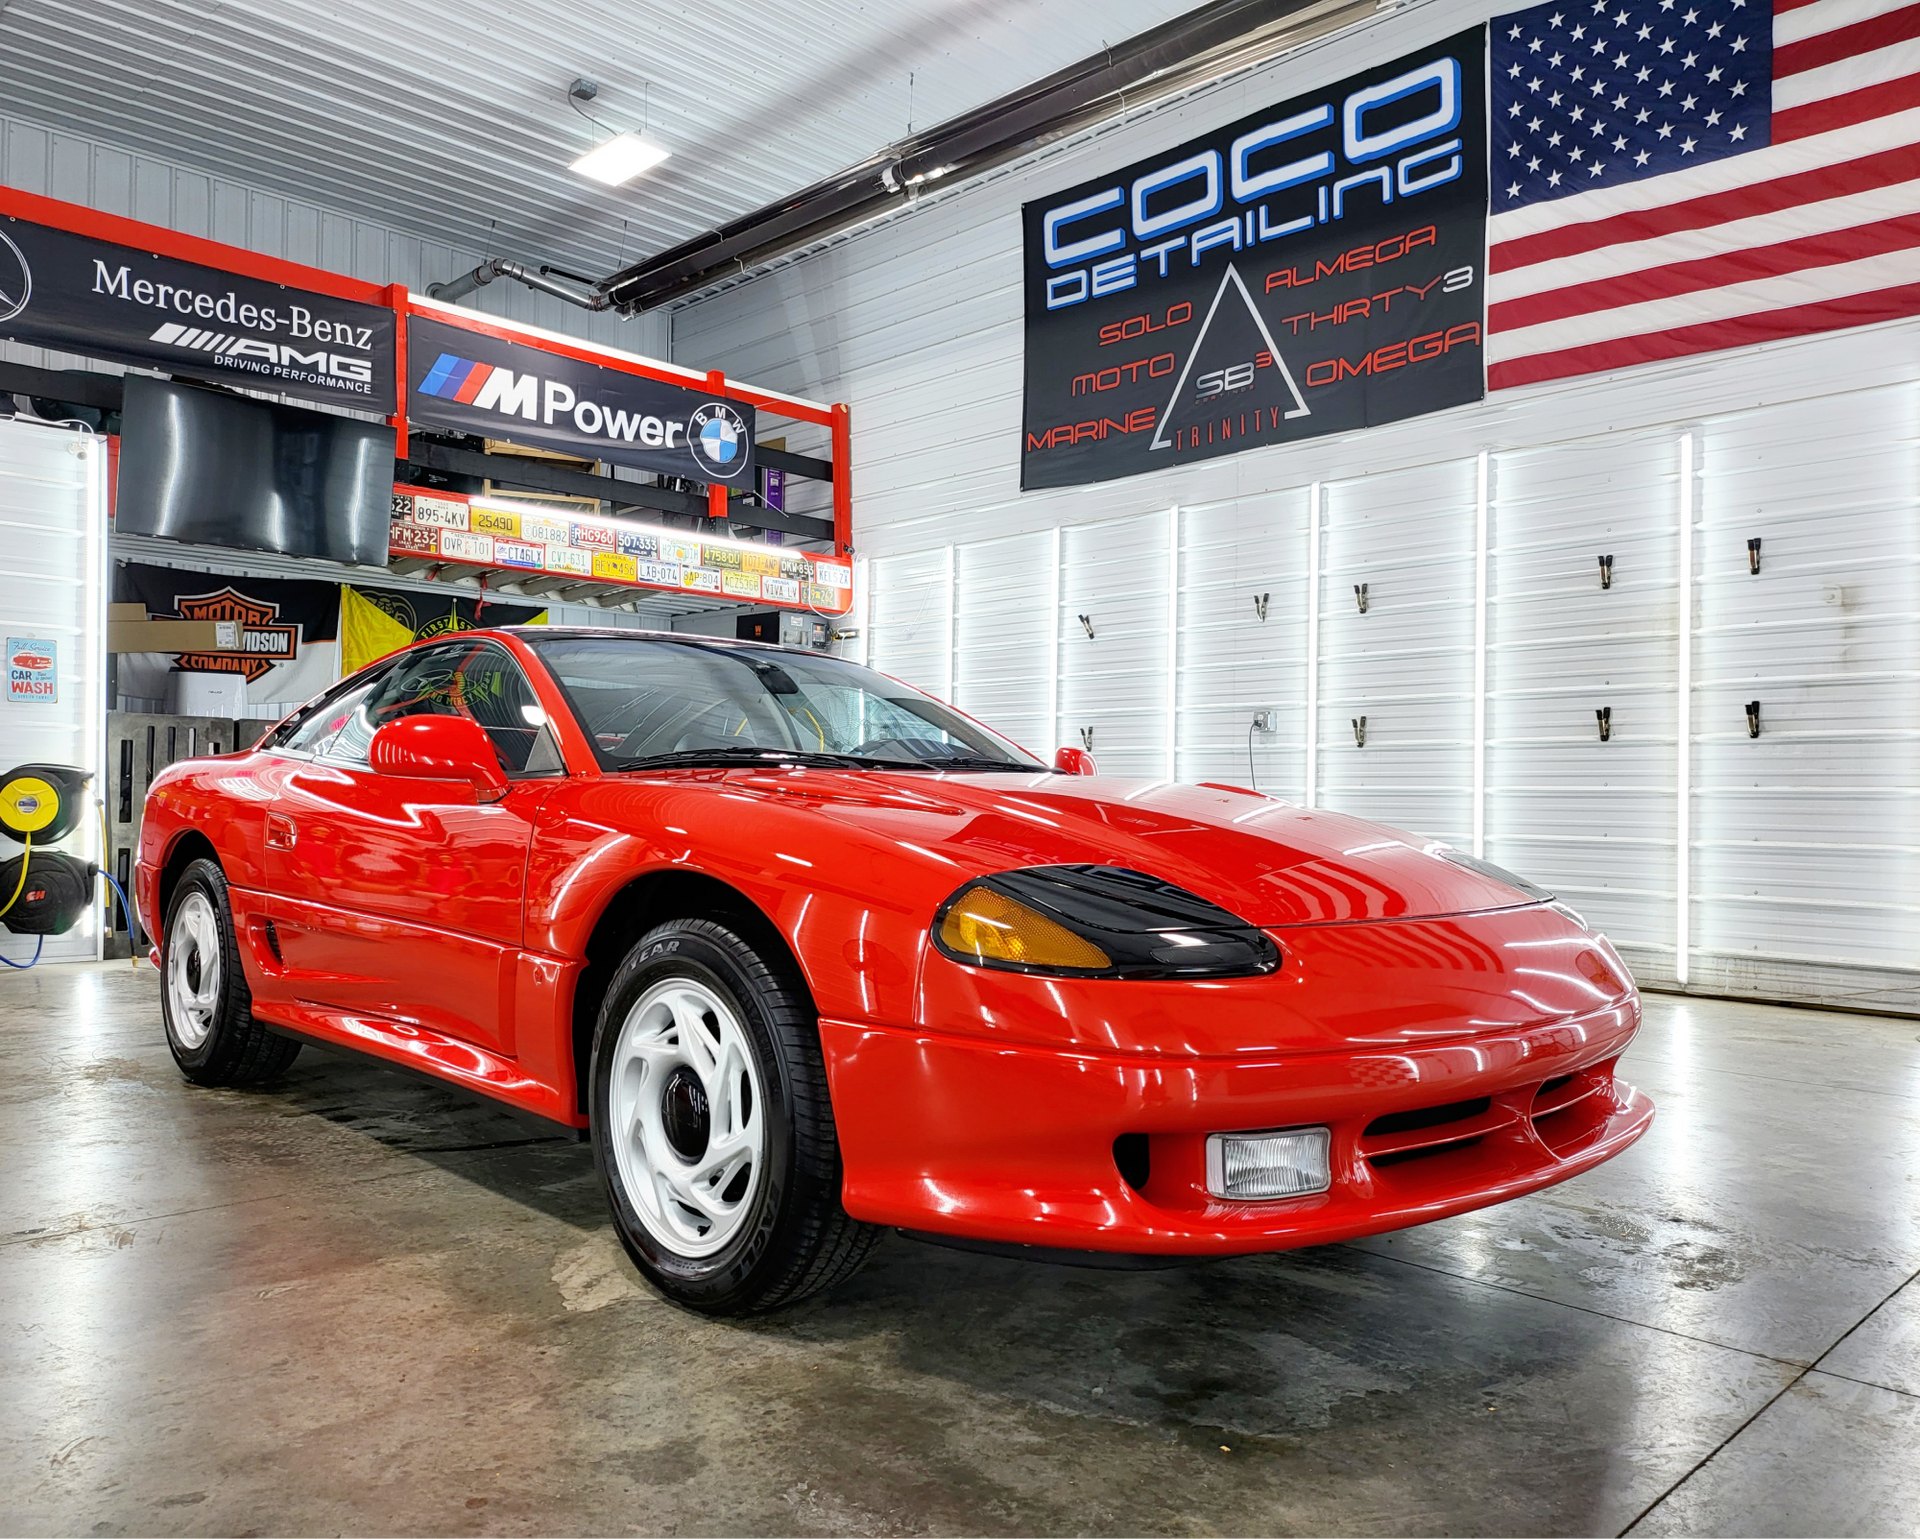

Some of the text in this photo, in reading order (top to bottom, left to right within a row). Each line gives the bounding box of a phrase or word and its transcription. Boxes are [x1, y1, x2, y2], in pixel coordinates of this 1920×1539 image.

[1043, 56, 1462, 269] COCO
[1265, 225, 1436, 294] ALMEGA
[91, 258, 373, 350] Mercedes-Benz
[1282, 265, 1473, 335] THIRTY3
[1099, 302, 1192, 346] SOLO
[214, 354, 372, 394] DRIVING PERFORMANCE
[226, 338, 372, 382] AMG
[1072, 352, 1175, 397] MOTO
[1306, 321, 1480, 387] OMEGA
[695, 405, 746, 435] BMW
[1027, 406, 1156, 452] MARINE
[1177, 406, 1279, 451] TRINITY
[574, 527, 614, 544] RHG960
[193, 599, 261, 625] MOTOR
[421, 619, 450, 639] FIRST
[12, 641, 51, 652] Full Service
[190, 655, 260, 676] COMPANY
[11, 670, 32, 681] CAR
[11, 680, 53, 695] WASH
[446, 692, 474, 706] MERCY
